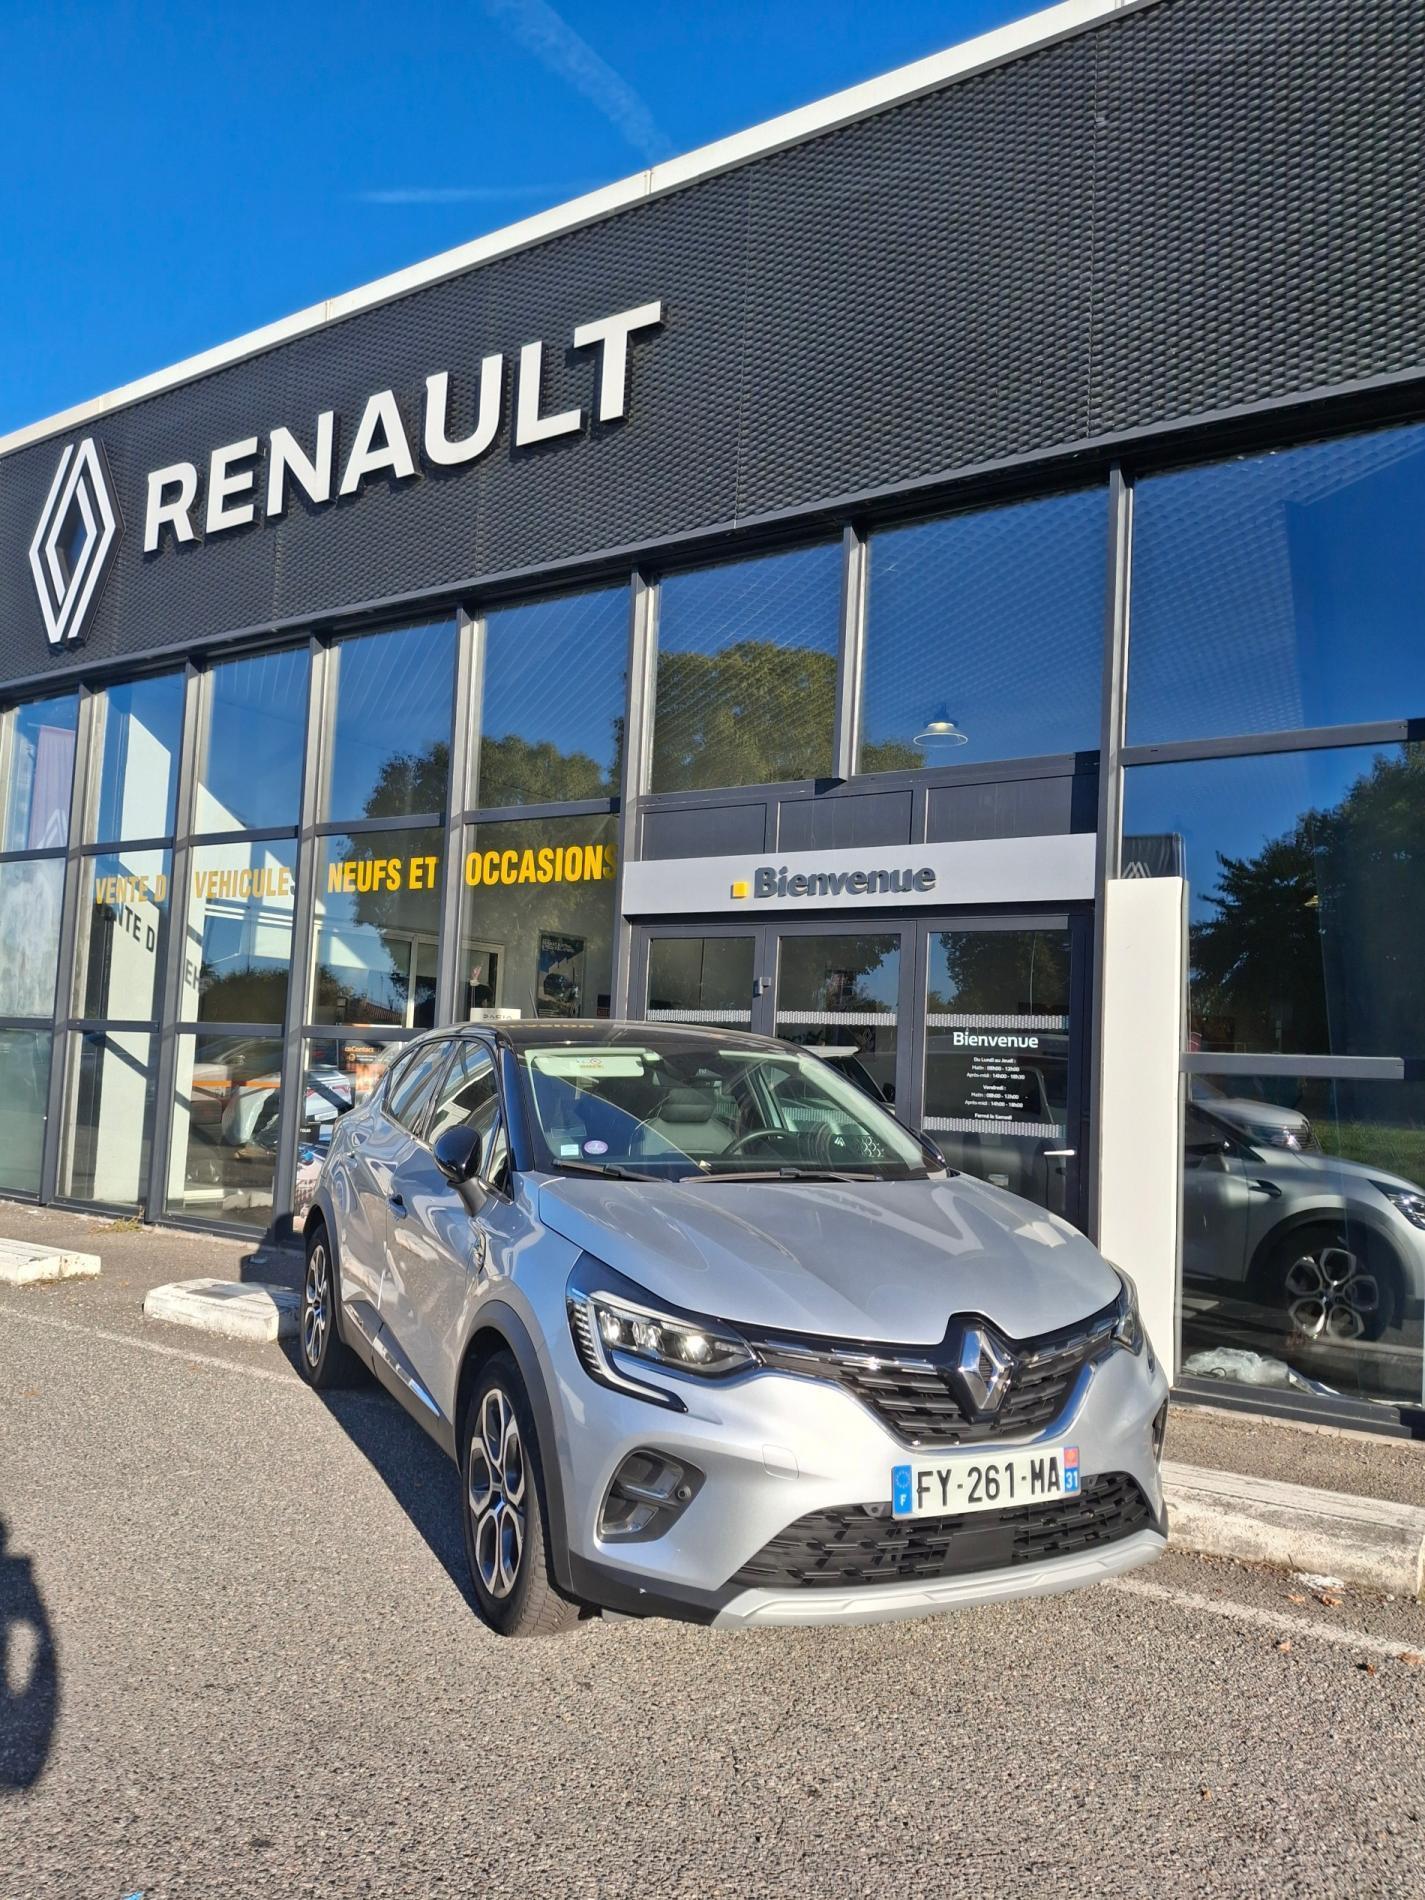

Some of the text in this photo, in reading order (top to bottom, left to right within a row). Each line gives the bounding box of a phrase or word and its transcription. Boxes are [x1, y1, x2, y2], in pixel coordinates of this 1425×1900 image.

[143, 301, 663, 552] RENAULT
[95, 875, 149, 905] VENTE
[327, 858, 402, 893] NEUFS
[409, 856, 438, 890] ET
[465, 845, 617, 886] OCCASIONS
[754, 865, 937, 899] Bienvenue
[952, 1031, 1039, 1048] Bienvenue
[917, 1456, 1061, 1509] FY-261-MA
[1066, 1471, 1078, 1489] 31
[900, 1493, 907, 1507] F
